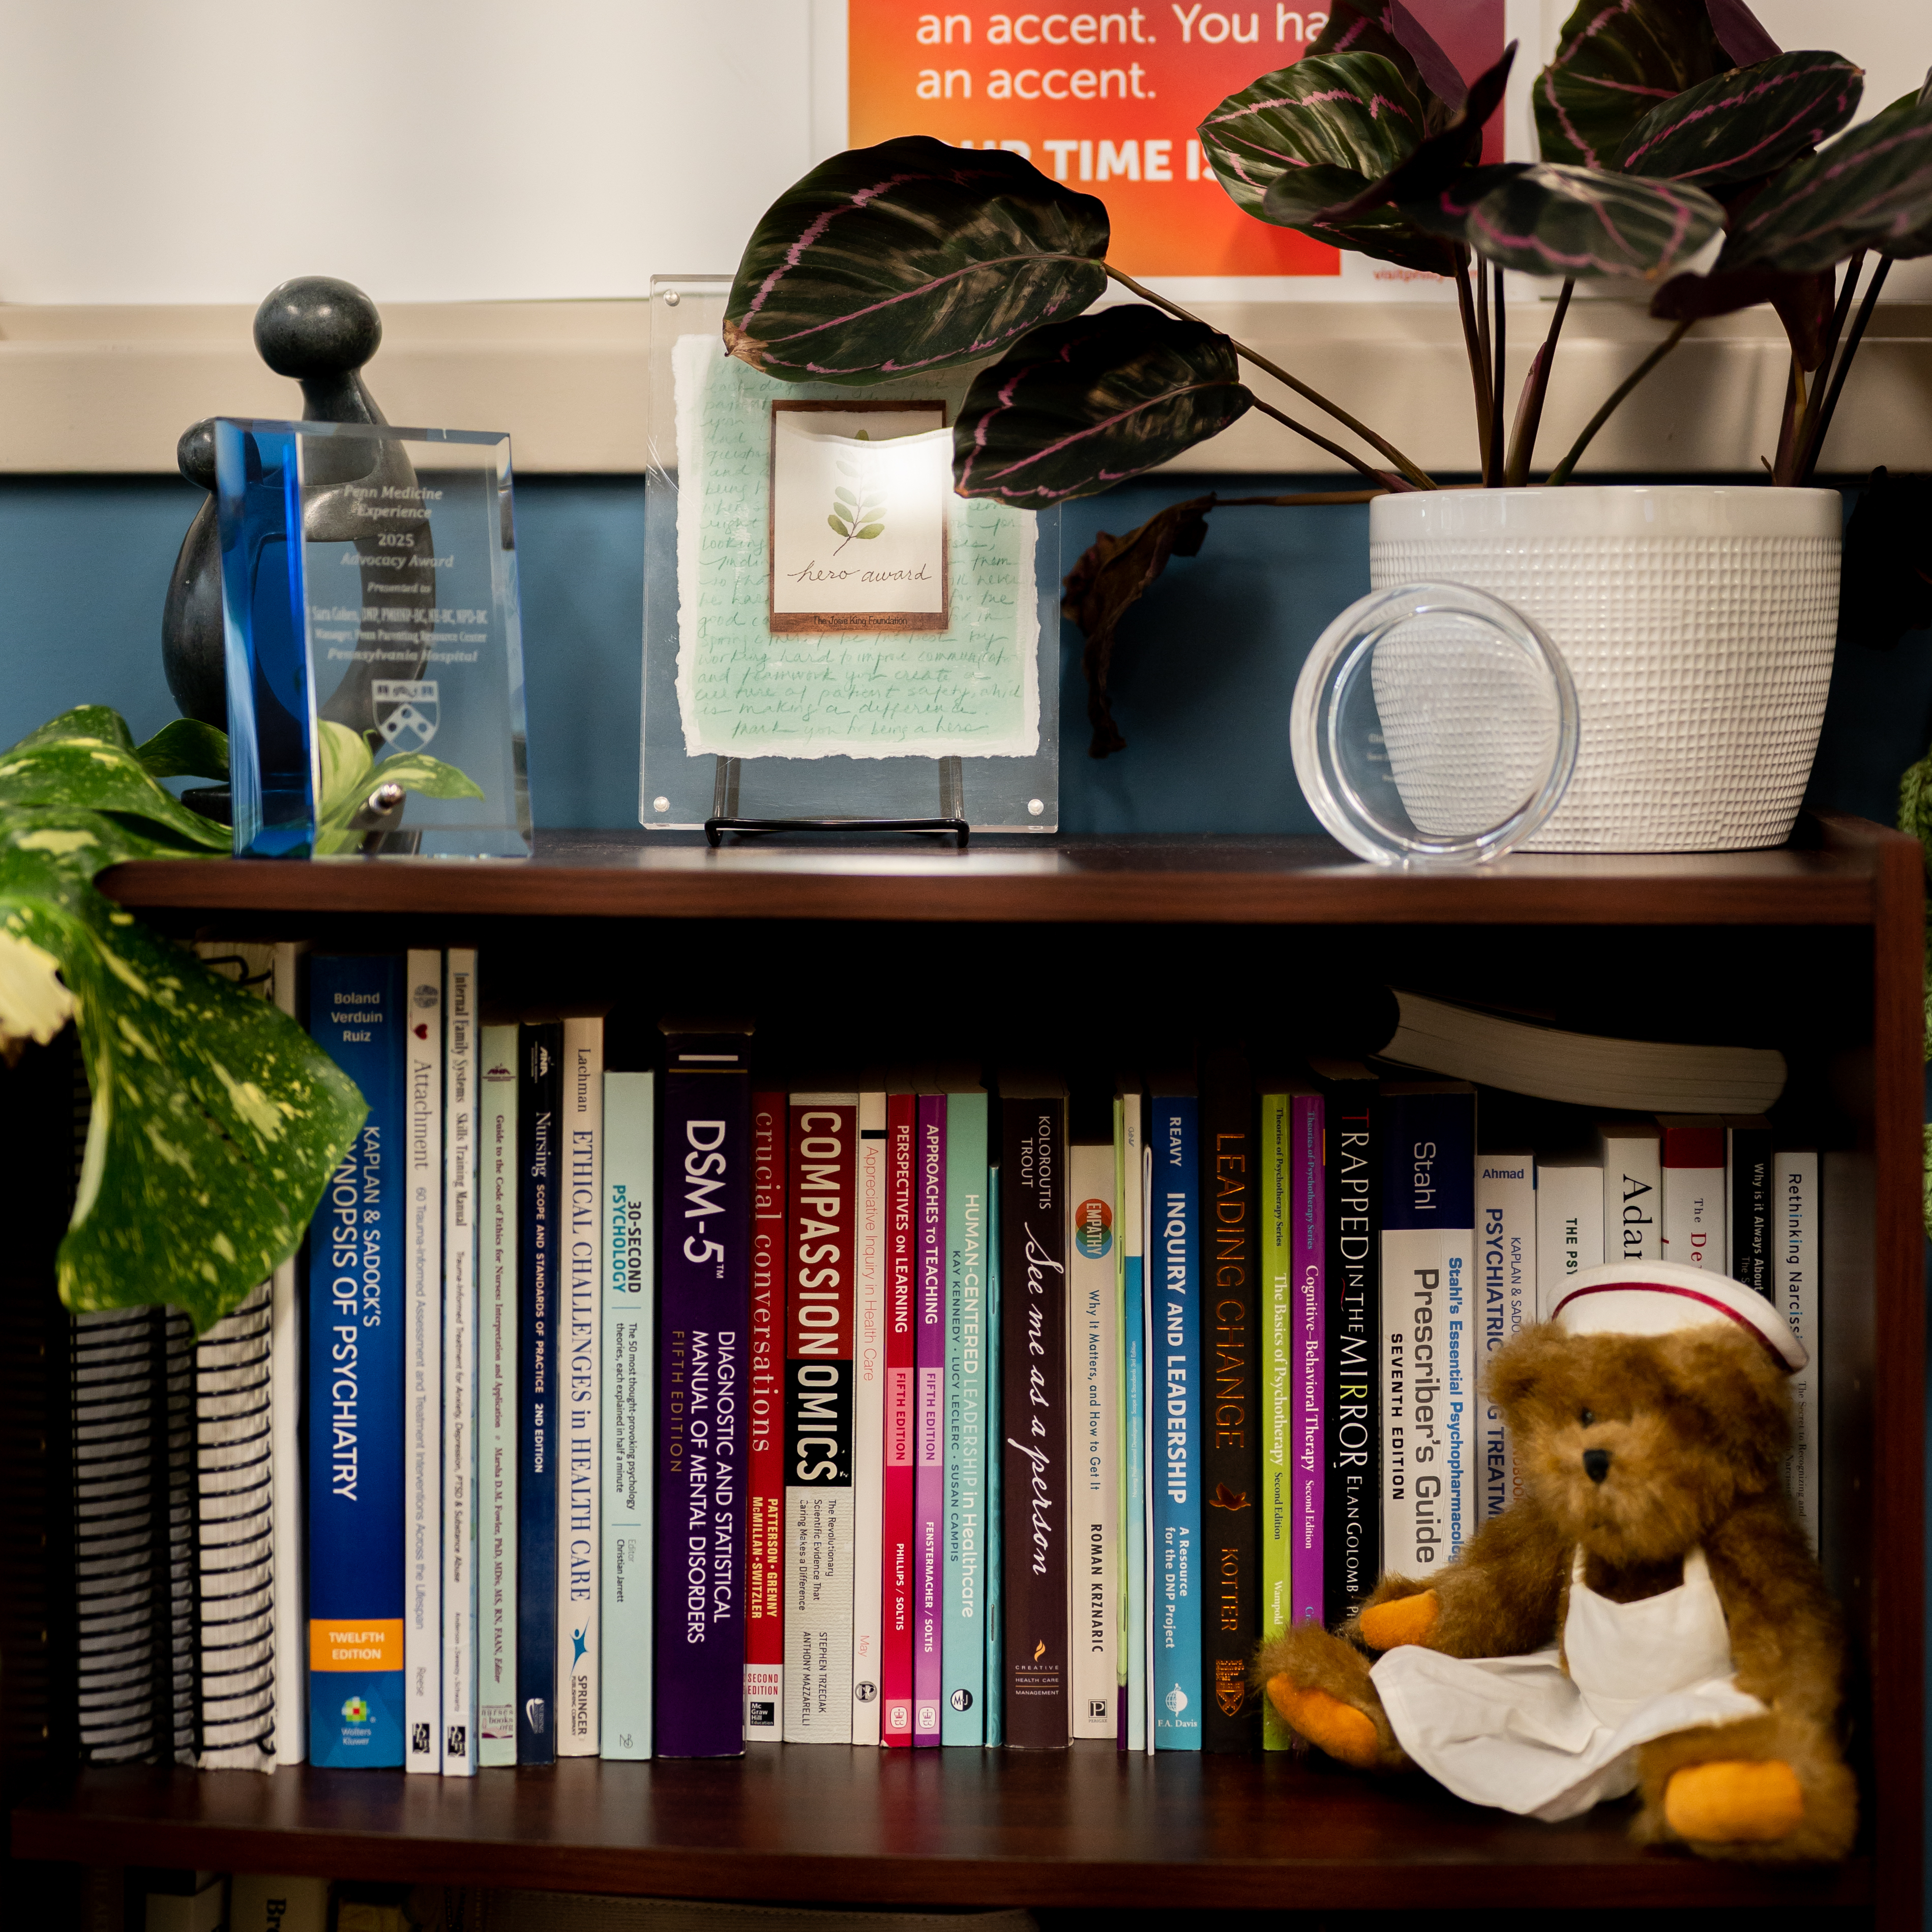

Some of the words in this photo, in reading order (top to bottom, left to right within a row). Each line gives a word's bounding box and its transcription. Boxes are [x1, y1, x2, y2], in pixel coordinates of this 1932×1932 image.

[915, 8, 974, 46] an
[986, 5, 1156, 46] accent.
[1171, 4, 1262, 46] You
[1276, 4, 1329, 45] ha
[915, 67, 974, 100] an
[986, 62, 1157, 100] accent.
[1043, 139, 1173, 183] TIME
[344, 485, 378, 498] Penn
[381, 486, 443, 500] Medicine
[358, 503, 432, 520] Experience
[340, 552, 407, 570] Advocacy
[408, 554, 454, 568] Award
[377, 533, 414, 547] 2025
[787, 560, 861, 583] hero
[861, 563, 933, 582] award
[813, 616, 827, 625] The
[828, 616, 849, 627] Josie
[850, 616, 867, 627] King
[868, 616, 907, 626] Foundation
[331, 1012, 383, 1023] Verduin
[334, 992, 380, 1004] Boland
[452, 972, 469, 1017] Internal
[342, 1030, 371, 1042] Ruiz
[450, 1019, 469, 1056] Family
[451, 1059, 468, 1103] Systems
[577, 1048, 591, 1113] Lachman
[413, 1059, 433, 1170] Attachment
[454, 1112, 469, 1142] Skills
[1275, 1108, 1284, 1146] Theories
[363, 1126, 380, 1204] KAPLAN
[451, 1144, 468, 1187] Training
[530, 1111, 551, 1177] Nursing
[753, 1112, 782, 1221] crucial
[1021, 1137, 1033, 1188] TROUT
[1038, 1116, 1051, 1210] KOLOROUTIS
[1169, 1117, 1182, 1167] REAVY
[1275, 1147, 1284, 1156] of
[572, 1130, 593, 1234] ETHICAL
[683, 1120, 726, 1263] DSM-5
[864, 1146, 879, 1231] Appreciative
[896, 1125, 910, 1230] PERSPECTIVES
[925, 1124, 939, 1223] APPROACHES
[1274, 1158, 1284, 1220] Psychotherapy
[1340, 1107, 1369, 1260] TRAPPED
[1413, 1142, 1436, 1210] Stahl
[1482, 1168, 1525, 1179] Ahmad
[1753, 1163, 1764, 1186] Why
[332, 1144, 358, 1268] YNOPSIS
[363, 1209, 381, 1225] &
[453, 1190, 468, 1226] Manual
[535, 1184, 546, 1220] SCOPE
[1215, 1134, 1245, 1287] LEADING
[1788, 1173, 1802, 1265] Rethinking
[535, 1224, 546, 1248] AND
[611, 1184, 626, 1293] PSYCHOLOGY
[627, 1201, 642, 1293] 30-SECOND
[896, 1234, 906, 1253] ON
[925, 1227, 936, 1243] TO
[1085, 1202, 1103, 1255] EMPATHY
[1164, 1193, 1185, 1295] INQUIRY
[1275, 1221, 1284, 1246] Series
[1753, 1216, 1763, 1255] Always
[363, 1229, 381, 1327] SADOCK'S
[863, 1235, 878, 1281] Inquiry
[952, 1250, 961, 1276] KAY
[964, 1194, 979, 1373] HUMAN-CENTERED
[1024, 1222, 1065, 1295] See
[1485, 1208, 1504, 1352] PSYCHIATRIC
[332, 1276, 358, 1316] OF
[535, 1253, 546, 1318] STANDARDS
[864, 1284, 877, 1296] in
[895, 1258, 908, 1333] LEARNING
[925, 1246, 938, 1324] TEACHING
[1273, 1273, 1287, 1301] The
[1448, 1257, 1462, 1314] Stahl's
[535, 1321, 546, 1336] OF
[570, 1241, 592, 1403] CHALLENGES
[863, 1300, 877, 1343] Health
[952, 1281, 961, 1343] KENNEDY
[1028, 1303, 1044, 1356] me
[1167, 1302, 1183, 1347] AND
[1273, 1304, 1287, 1346] Basics
[534, 1340, 546, 1393] PRACTICE
[671, 1331, 685, 1382] FIFTH
[752, 1234, 779, 1452] conversations
[863, 1349, 877, 1381] Care
[1273, 1349, 1287, 1364] of
[1413, 1268, 1441, 1463] Prescriber's
[1448, 1321, 1463, 1395] Essential
[691, 1330, 709, 1414] MANUAL
[716, 1331, 735, 1455] DIAGNOSTIC
[951, 1357, 960, 1389] LUCY
[1029, 1364, 1050, 1407] as
[1215, 1298, 1245, 1448] CHANGE
[1390, 1333, 1403, 1417] SEVENTH
[332, 1326, 358, 1501] PSYCHIATRY
[534, 1403, 544, 1426] 2ND
[571, 1410, 590, 1430] in
[950, 1394, 960, 1451] LECLERC
[1031, 1415, 1046, 1436] a
[1270, 1367, 1287, 1466] Psychotherapy
[1339, 1334, 1369, 1467] MIRROR
[534, 1429, 544, 1473] EDITION
[670, 1391, 683, 1473] EDITION
[691, 1420, 707, 1448] OF
[961, 1379, 978, 1487] LEADERSHIP
[1167, 1355, 1186, 1504] LEADERSHIP
[1300, 1415, 1319, 1472] Therapy
[570, 1437, 592, 1531] HEALTH
[716, 1462, 733, 1506] AND
[950, 1464, 960, 1508] SUSAN
[1391, 1427, 1404, 1500] EDITION
[689, 1454, 707, 1530] MENTAL
[962, 1492, 977, 1508] in
[1007, 1438, 1052, 1576] person
[1346, 1476, 1362, 1519] ELAN
[751, 1496, 764, 1555] McMILLAN
[765, 1498, 779, 1564] PATTERSON
[950, 1512, 959, 1562] CAMPIS
[1414, 1475, 1441, 1563] Guide
[570, 1539, 591, 1602] CARE
[615, 1538, 626, 1574] Christian
[714, 1512, 732, 1623] STATISTICAL
[896, 1543, 905, 1586] PHILLIPS
[924, 1521, 935, 1609] FENSTERMACHER
[961, 1514, 977, 1618] Healthcare
[1090, 1524, 1103, 1576] ROMAN
[1346, 1523, 1362, 1592] GOLOMB
[615, 1576, 626, 1602] Jarrett
[687, 1536, 706, 1644] DISORDERS
[751, 1563, 764, 1619] SWITZLER
[765, 1572, 779, 1617] GRENNY
[895, 1596, 905, 1630] SOLTIS
[1221, 1548, 1238, 1631] KOTTER
[329, 1631, 384, 1642] TWELFTH
[924, 1618, 934, 1652] SOLTIS
[1091, 1583, 1104, 1653] KRZNARIC
[331, 1649, 381, 1659] EDITION
[802, 1631, 811, 1671] ANTHONY
[818, 1631, 827, 1671] STEPHEN
[577, 1675, 588, 1736] SPRINGER
[801, 1673, 811, 1727] MAZZARELLI
[818, 1673, 827, 1713] TRZECIAK
